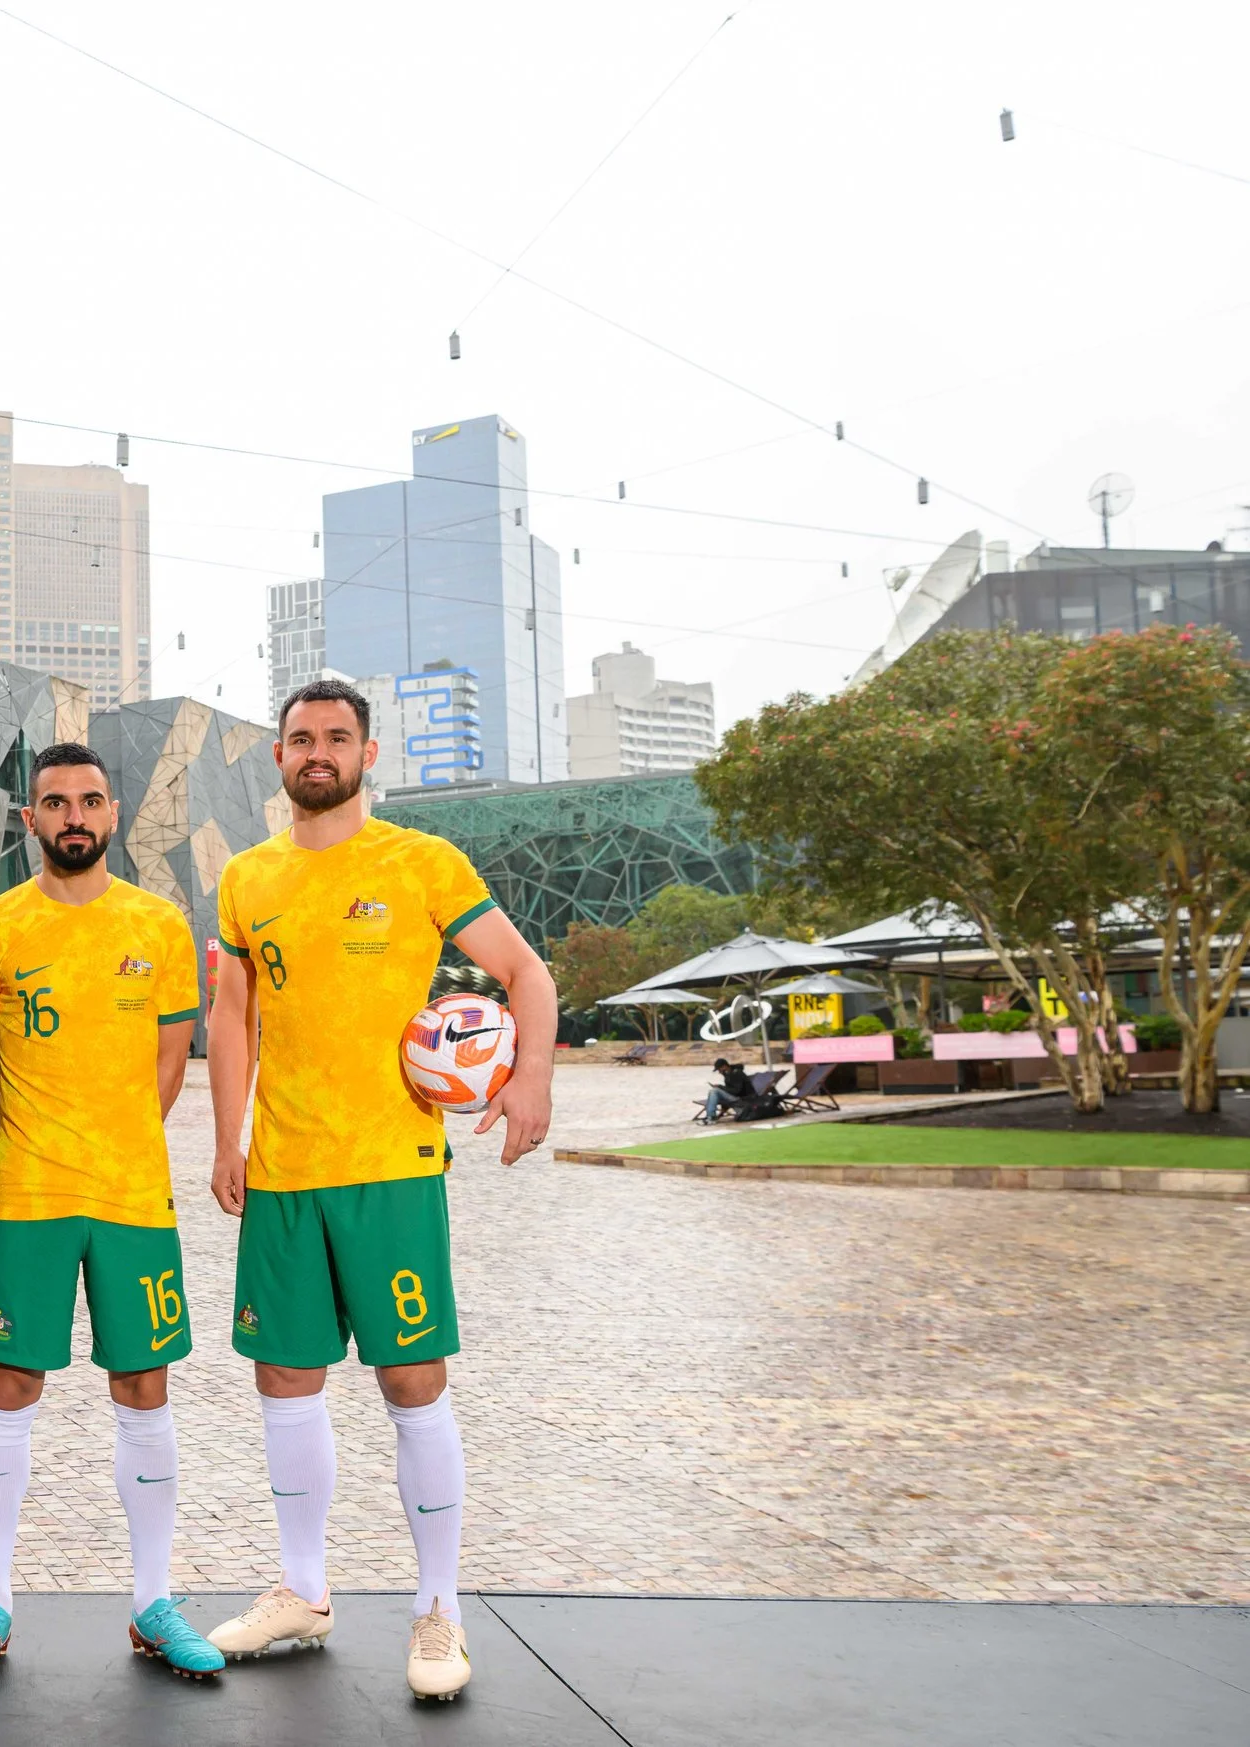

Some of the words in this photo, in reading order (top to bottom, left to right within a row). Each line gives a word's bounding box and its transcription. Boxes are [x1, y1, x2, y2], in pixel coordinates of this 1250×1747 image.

[260, 940, 287, 990] 8
[17, 987, 60, 1037] 16
[139, 1269, 182, 1330] 16
[391, 1269, 428, 1325] 8
